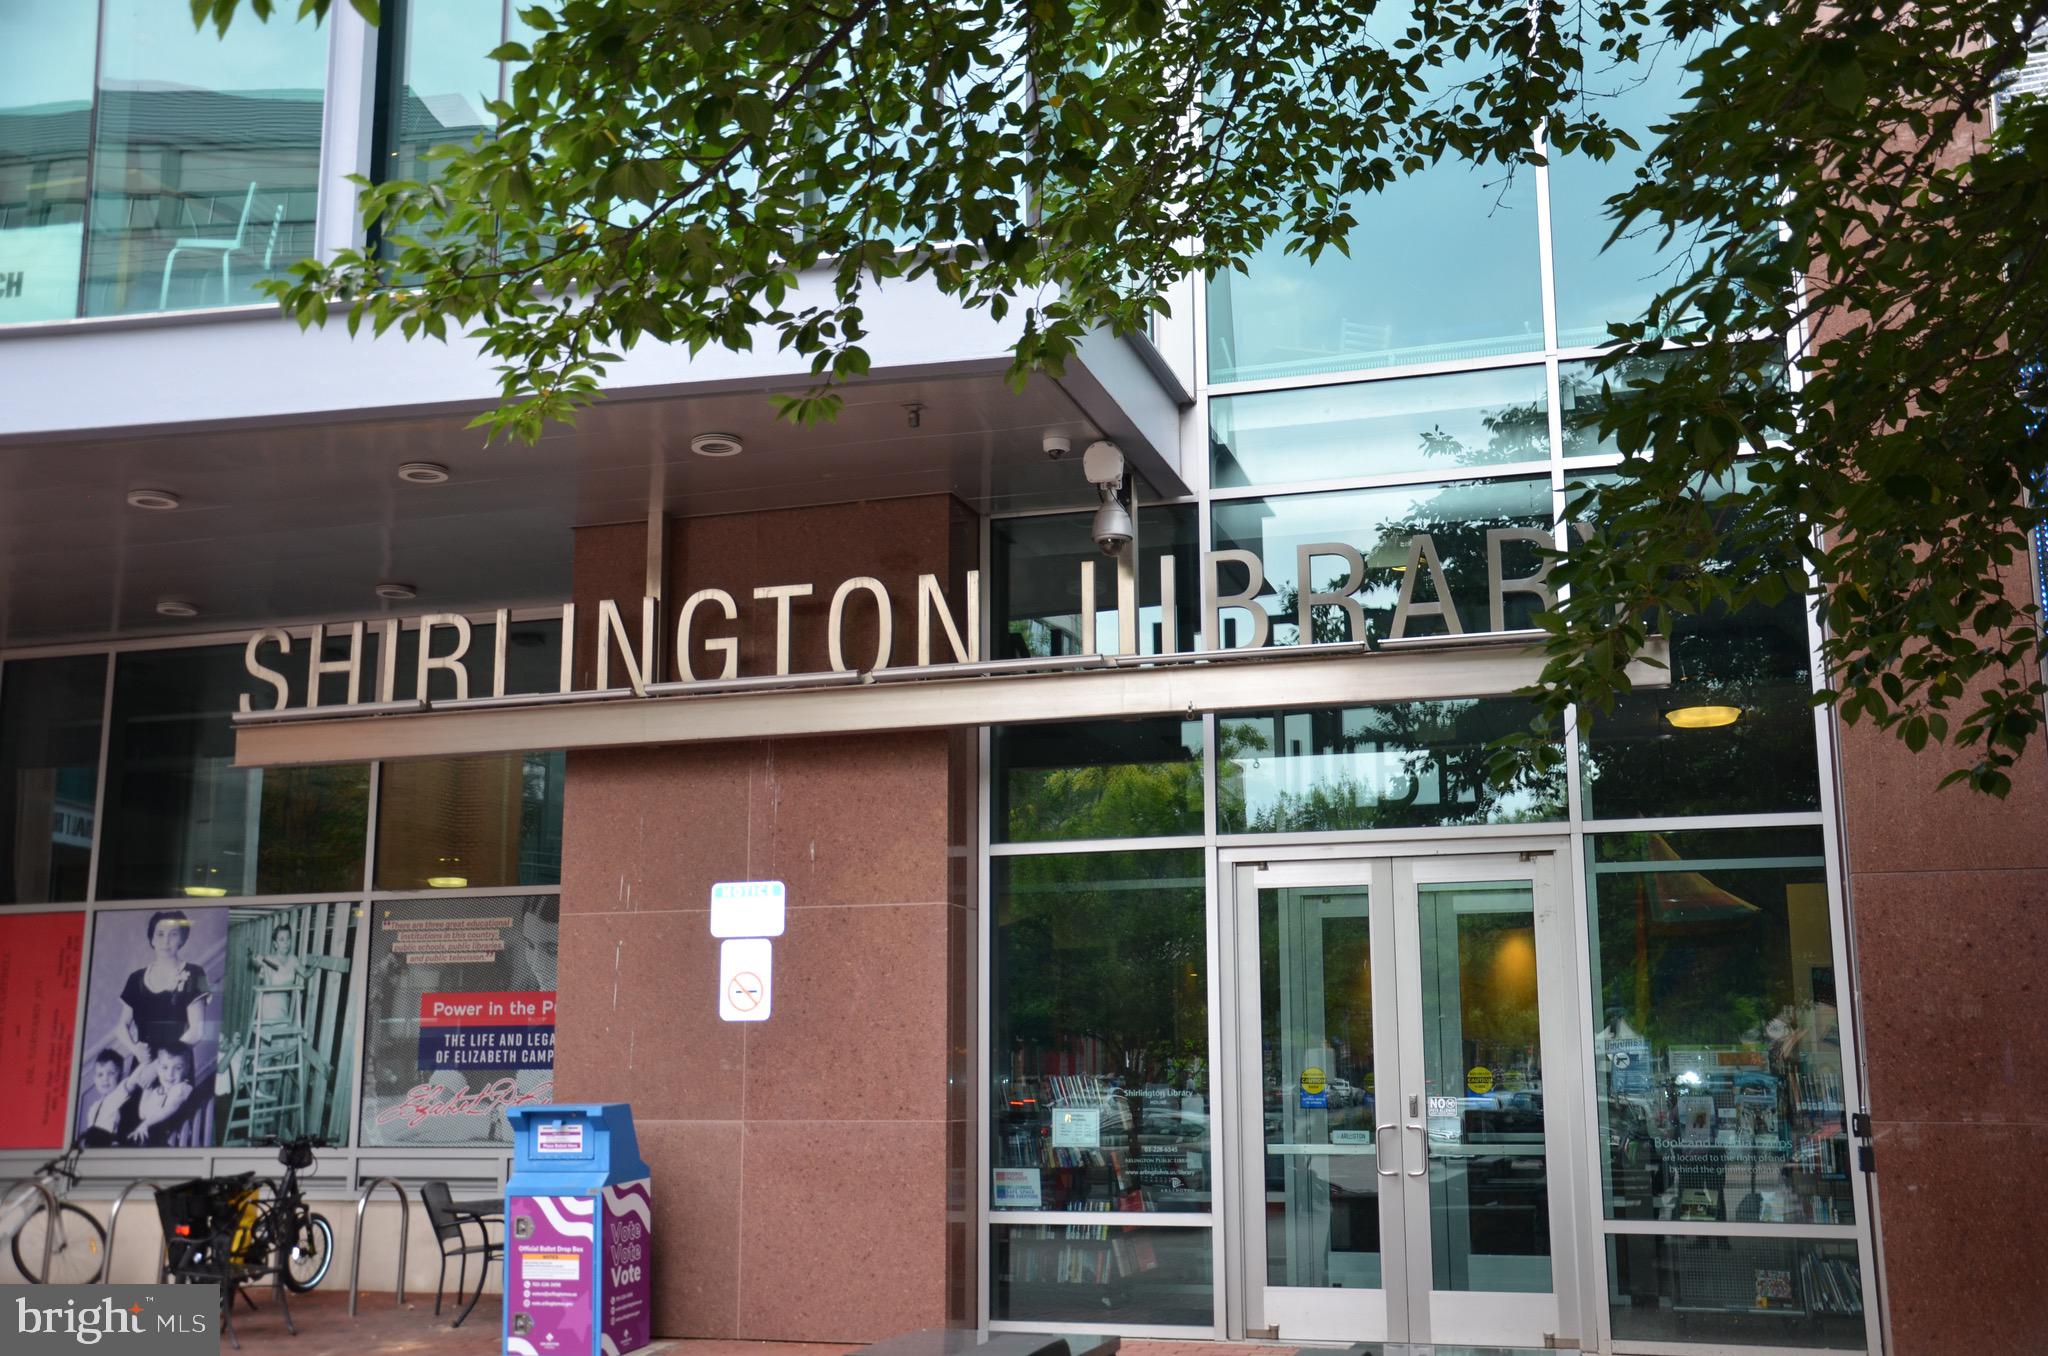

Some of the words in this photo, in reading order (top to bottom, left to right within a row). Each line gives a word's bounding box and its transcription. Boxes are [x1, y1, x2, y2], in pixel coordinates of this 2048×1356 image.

[240, 570, 981, 713] SHIRLINGTON
[1081, 522, 1602, 657] LIBRAR
[433, 1002, 483, 1017] Power
[488, 1001, 503, 1016] in
[509, 1001, 536, 1016] the
[542, 1000, 557, 1015] P
[444, 1033, 466, 1047] THE
[470, 1033, 496, 1047] LIFE
[499, 1033, 523, 1047] AND
[435, 1050, 450, 1064] OF
[454, 1049, 517, 1064] ELIZABETH
[521, 1049, 555, 1063] CAMP
[1124, 1089, 1166, 1099] Shirlington
[1167, 1089, 1194, 1097] Library
[1430, 1098, 1446, 1109] NO
[1677, 1153, 1708, 1162] located
[1710, 1154, 1719, 1162] to
[1669, 1164, 1699, 1173] behind
[1700, 1165, 1715, 1174] the
[610, 1220, 641, 1245] Vote
[610, 1242, 641, 1267] Vote
[610, 1264, 641, 1289] Vote
